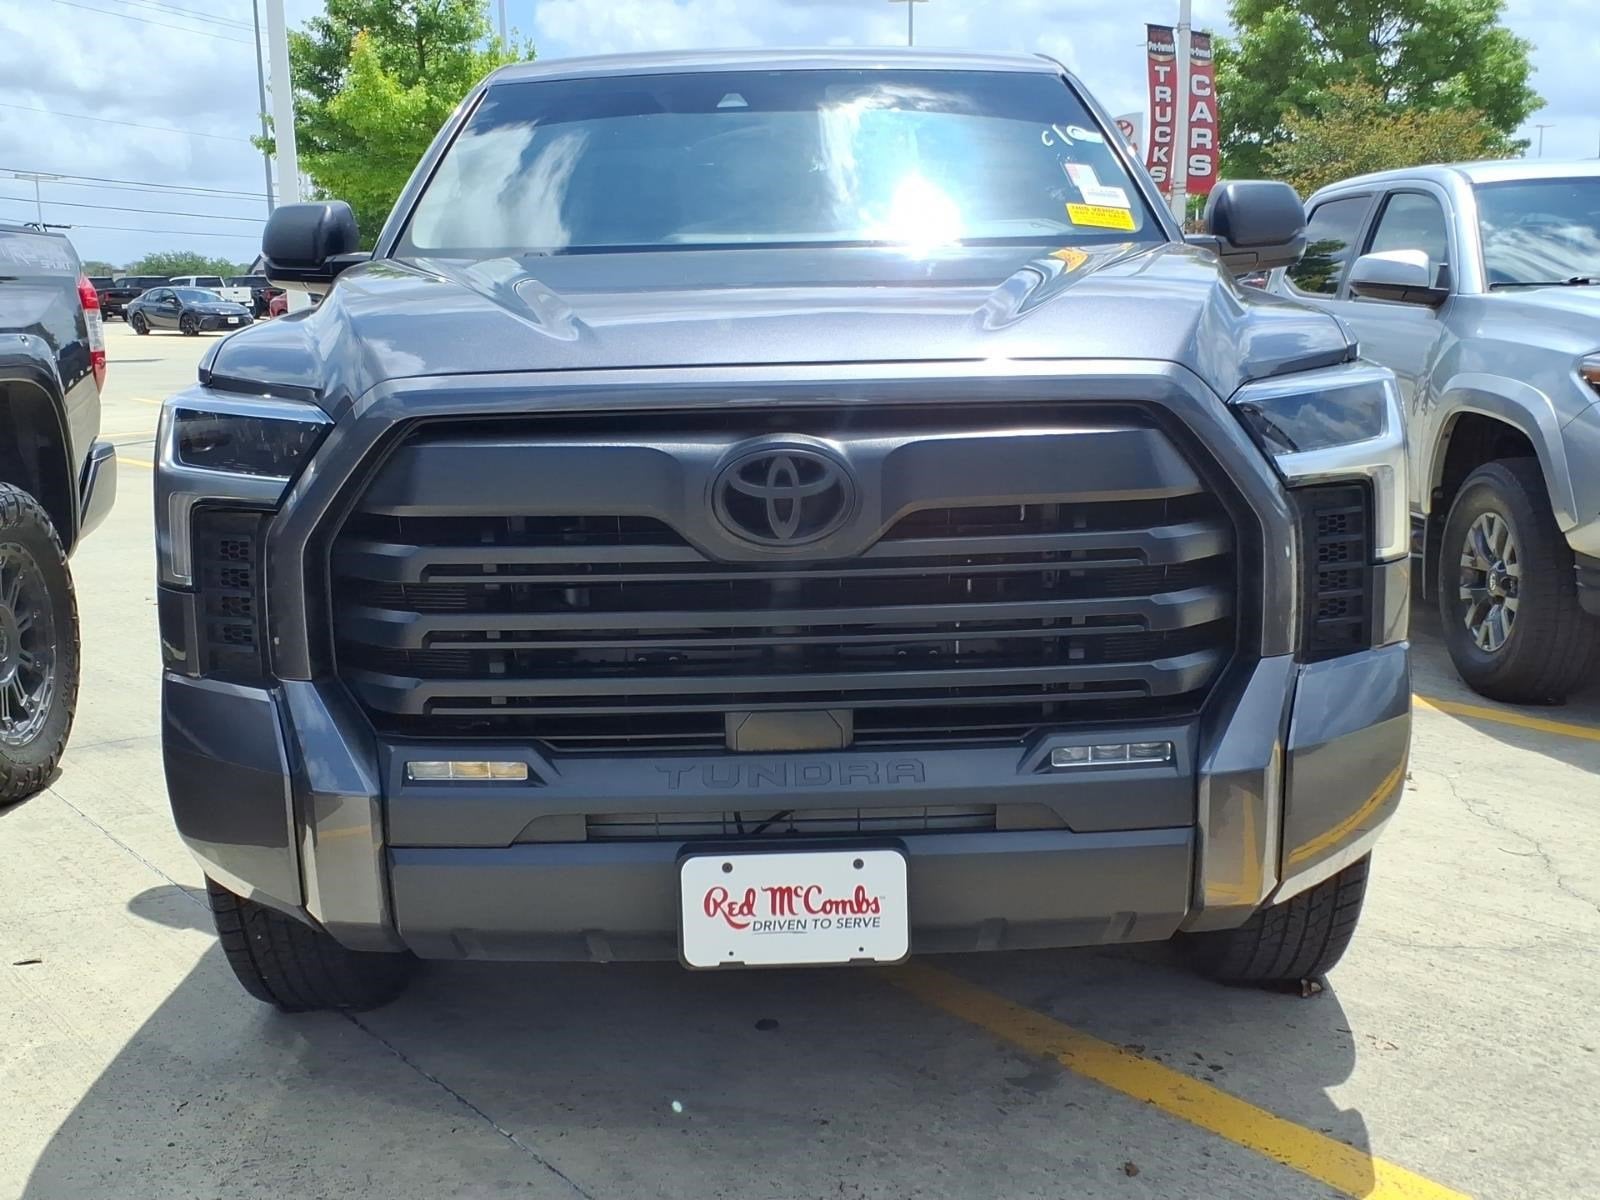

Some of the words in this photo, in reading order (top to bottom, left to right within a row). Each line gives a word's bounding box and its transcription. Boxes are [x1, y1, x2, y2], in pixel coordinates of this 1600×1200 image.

[1149, 66, 1172, 182] TRUCKS
[1188, 74, 1214, 176] CARS
[655, 757, 926, 790] TUNDRA
[703, 886, 757, 930] Red
[761, 884, 881, 917] McCombs
[752, 919, 807, 932] DRIVEN
[812, 918, 832, 930] TO
[836, 916, 881, 929] SERVE
